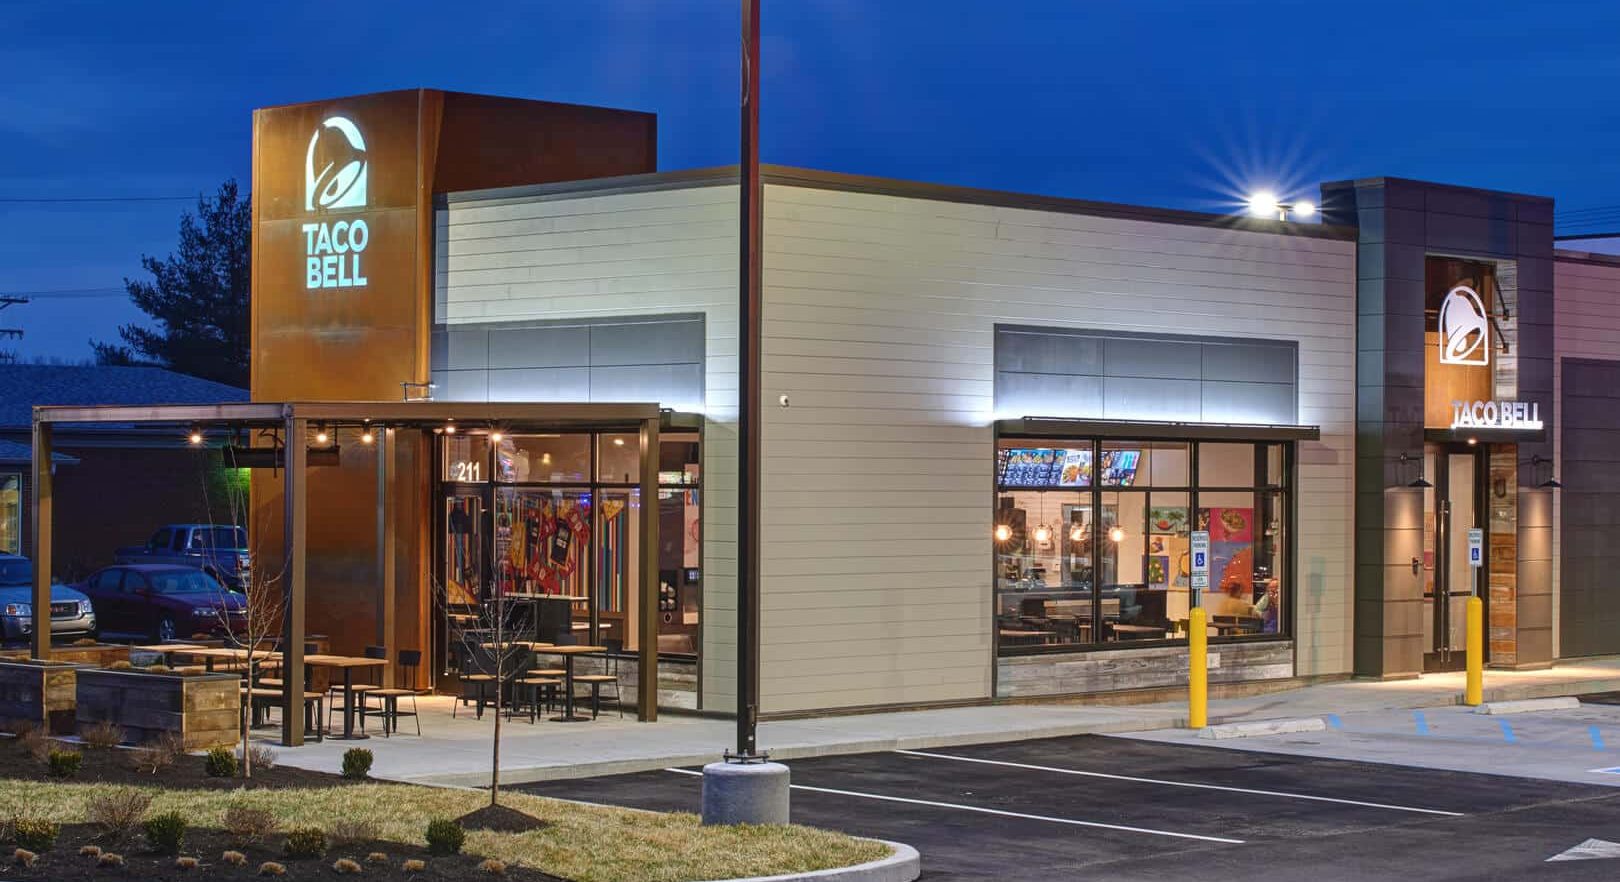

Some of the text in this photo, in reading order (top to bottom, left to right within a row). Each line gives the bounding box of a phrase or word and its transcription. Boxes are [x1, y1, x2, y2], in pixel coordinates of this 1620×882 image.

[302, 219, 368, 255] TACO
[306, 254, 367, 289] BELL
[1451, 400, 1543, 429] TACO BELL
[457, 461, 480, 482] 211
